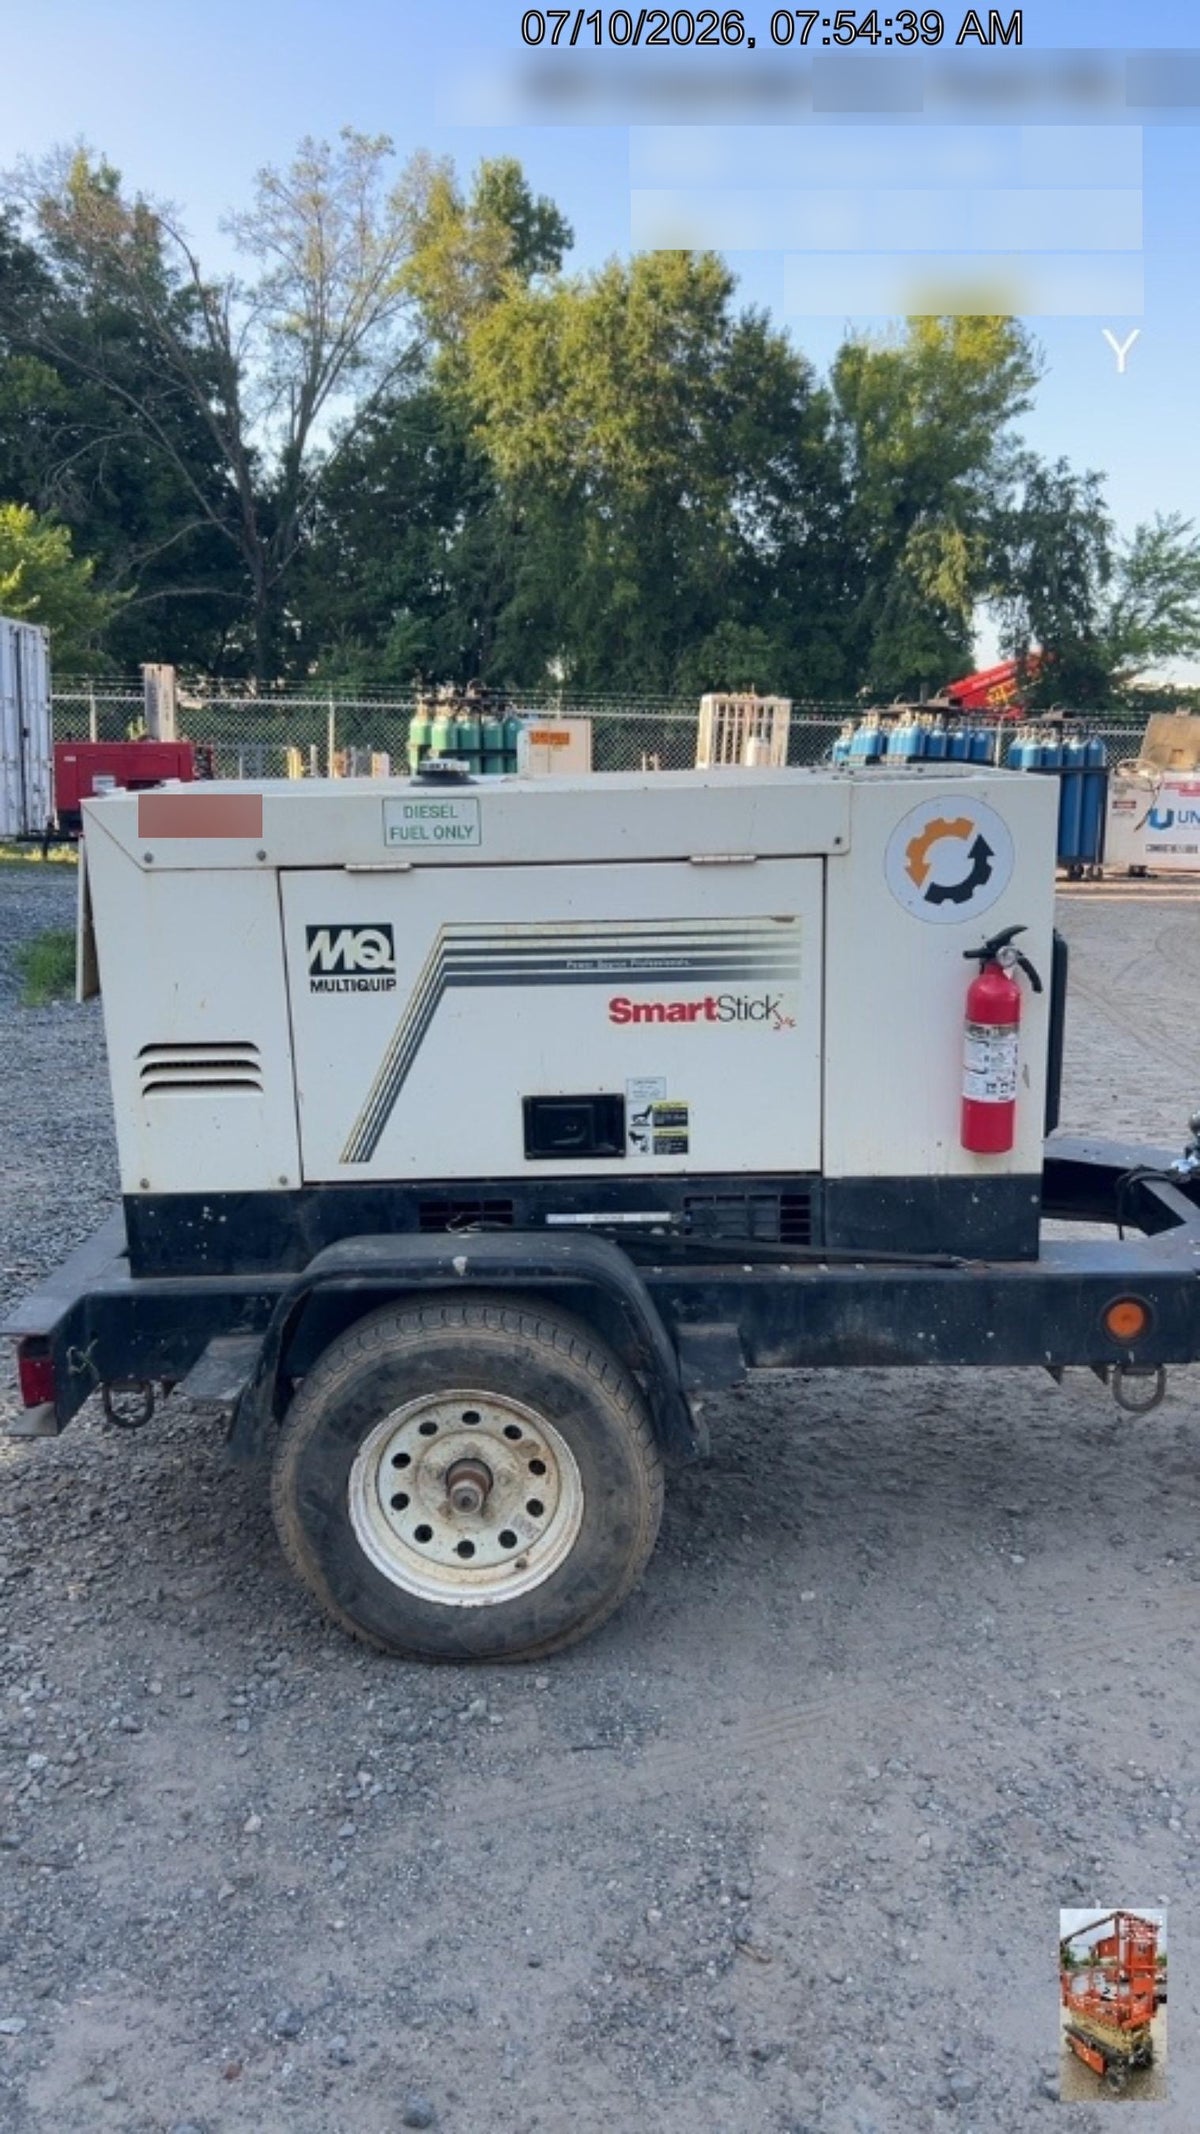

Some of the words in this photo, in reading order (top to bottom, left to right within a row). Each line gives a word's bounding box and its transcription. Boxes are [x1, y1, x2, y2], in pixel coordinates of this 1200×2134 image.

[403, 805, 459, 819] DIESEL
[390, 826, 430, 840] FUEL
[433, 824, 475, 841] ONLY
[307, 928, 396, 971] MQ
[310, 978, 397, 994] MULTIQUIP
[608, 993, 783, 1025] SmartStick
